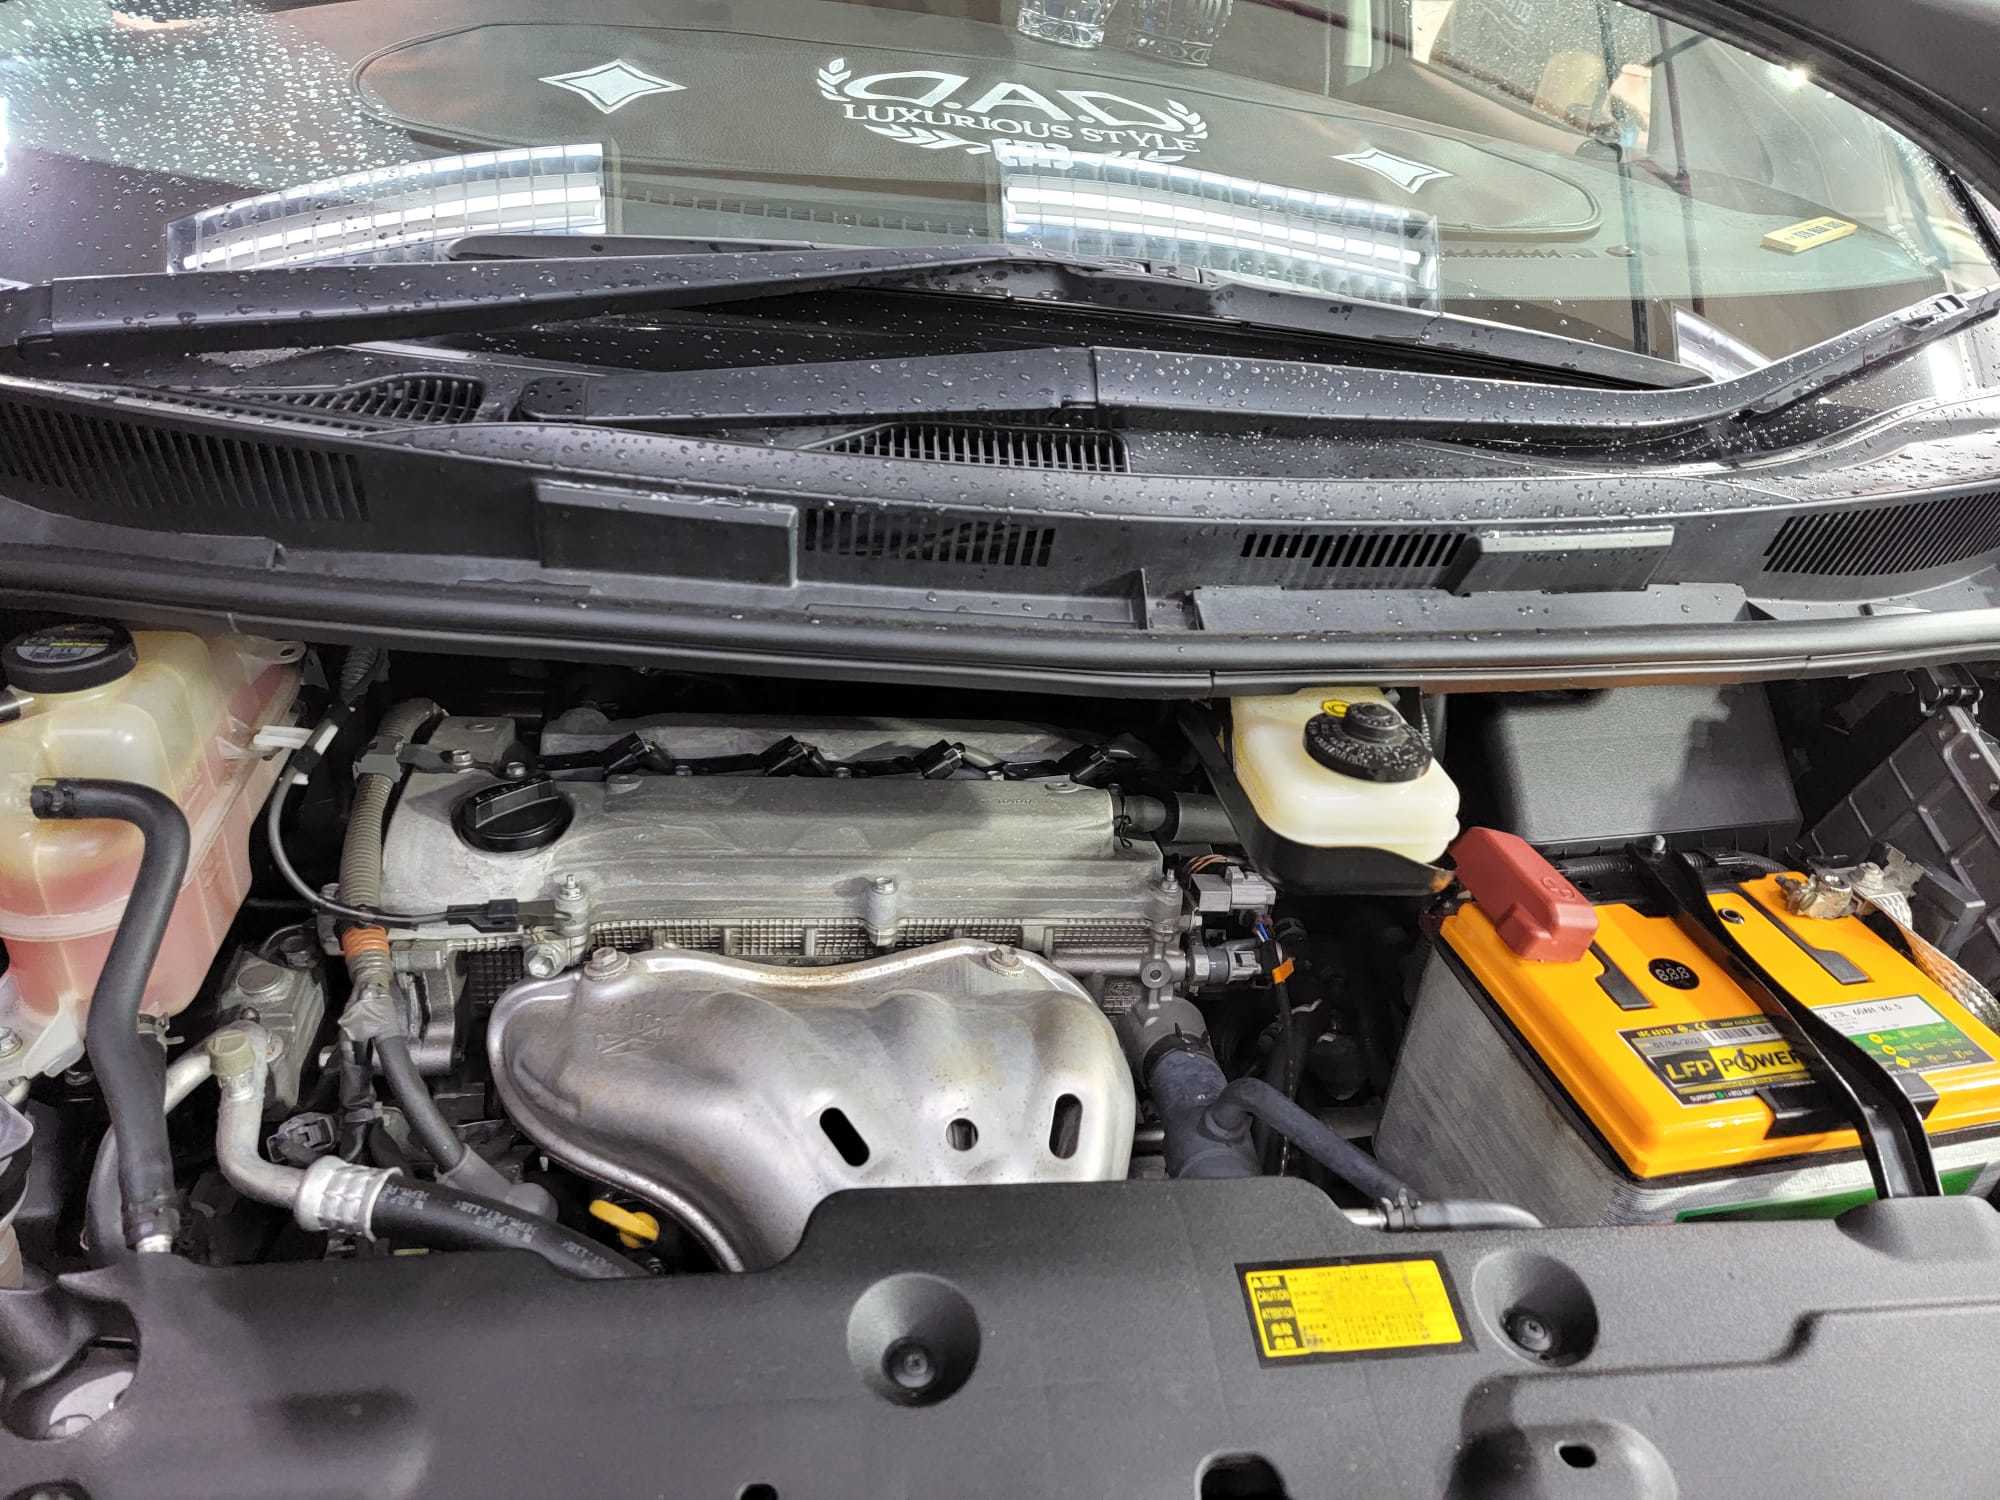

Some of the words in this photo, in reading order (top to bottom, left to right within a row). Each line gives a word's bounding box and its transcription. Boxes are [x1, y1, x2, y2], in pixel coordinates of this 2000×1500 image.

[843, 103, 1072, 140] LUXURIOUS
[1083, 125, 1201, 153] STYLE
[1664, 1058, 1714, 1080] LFP
